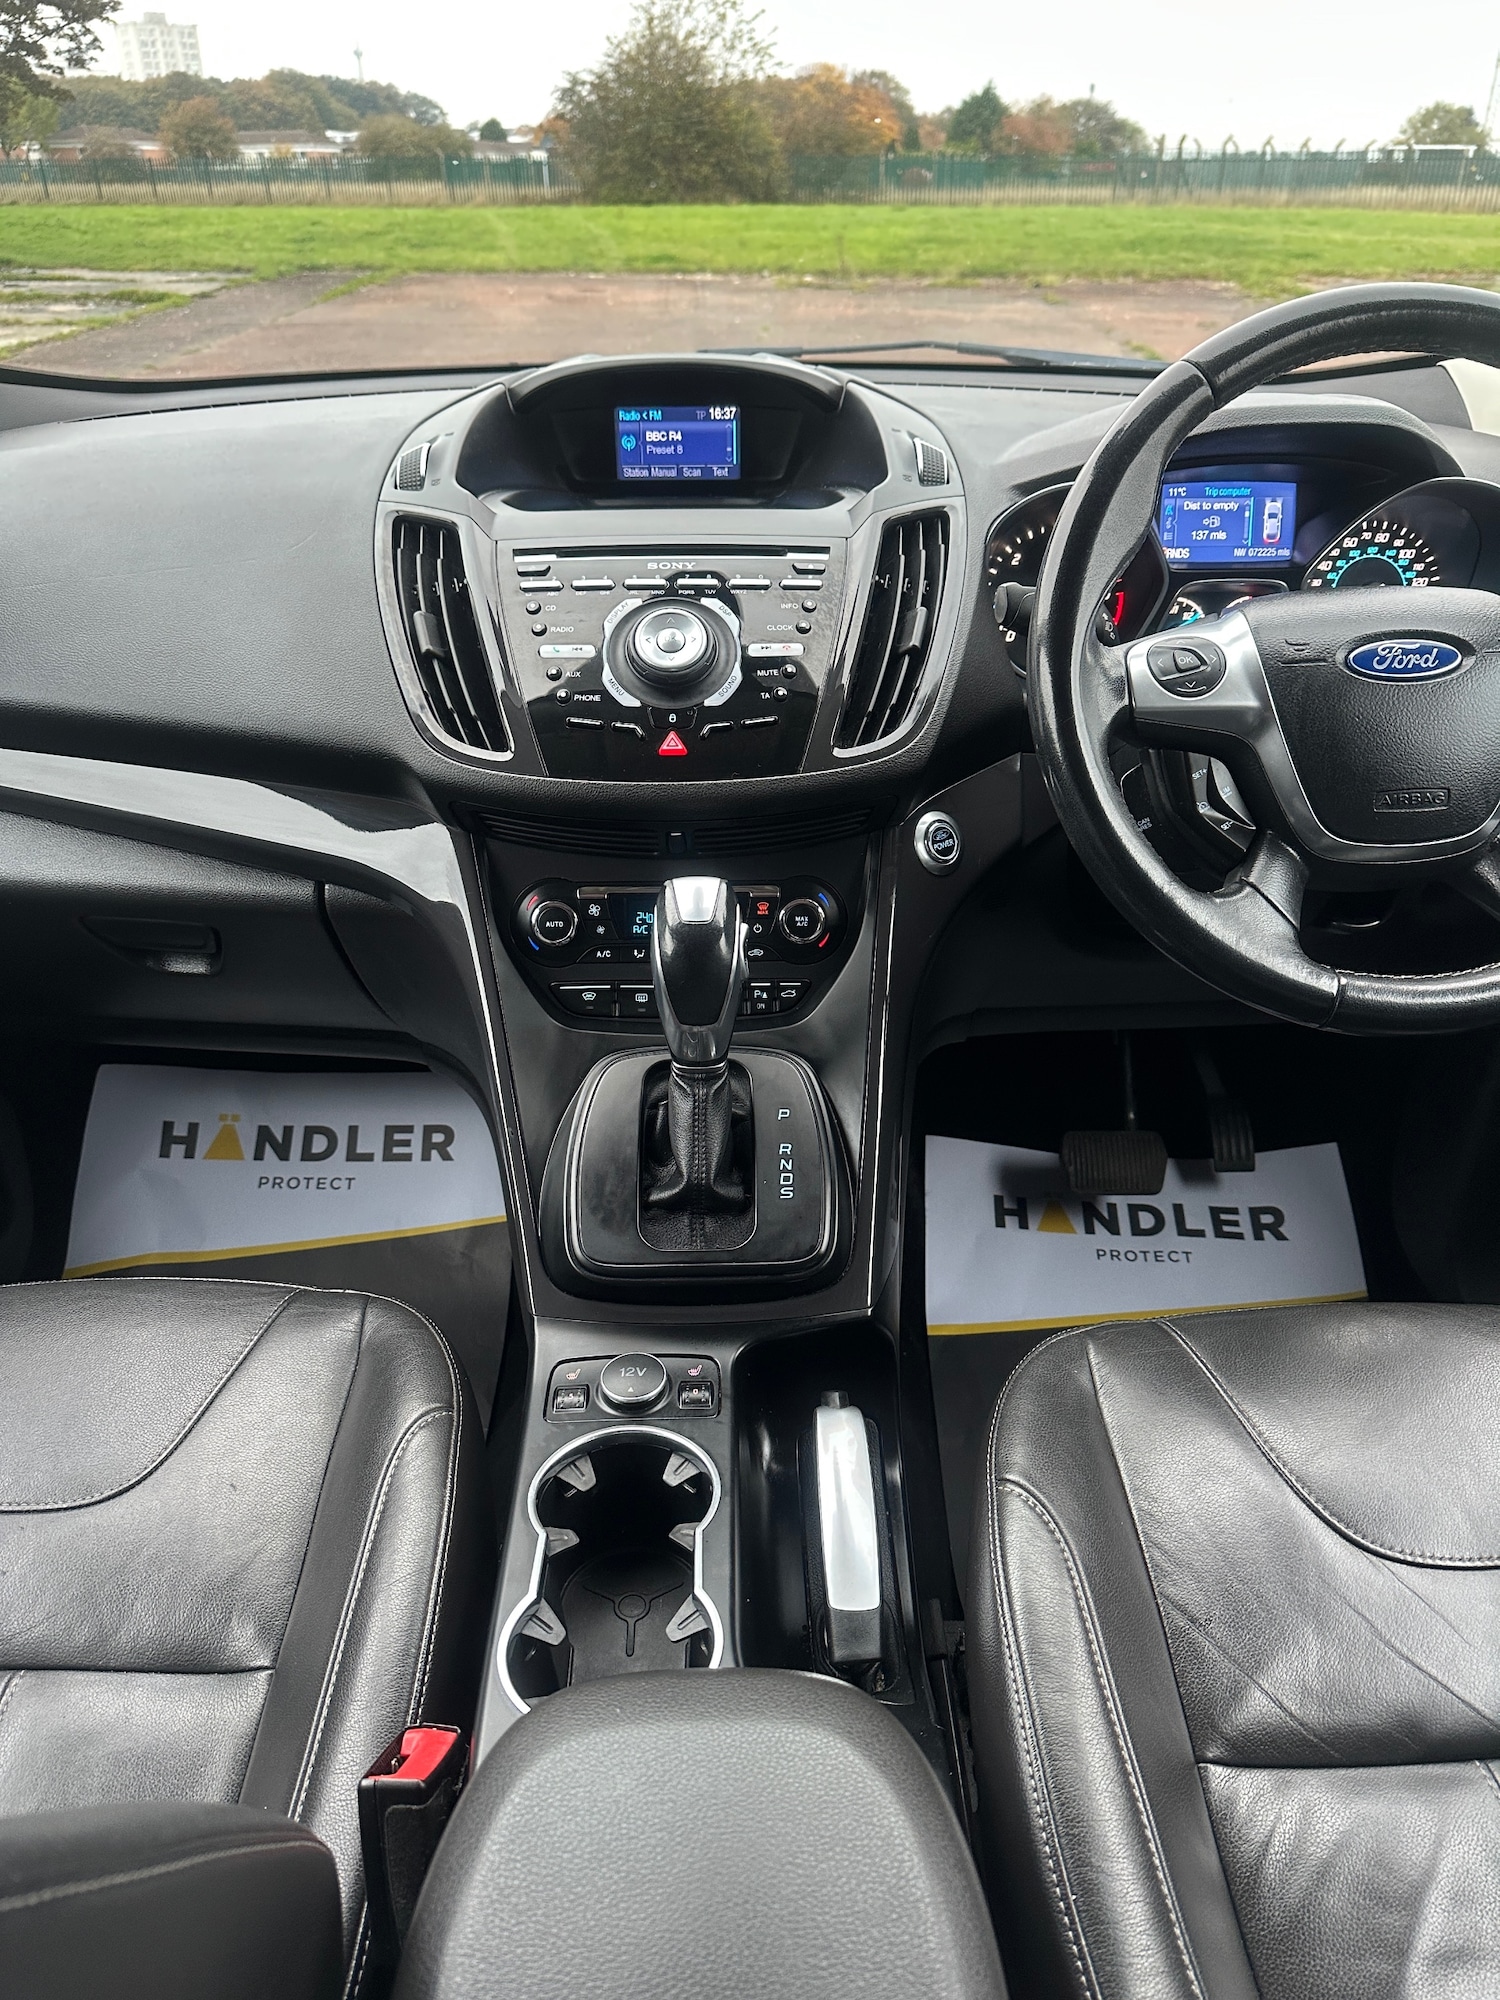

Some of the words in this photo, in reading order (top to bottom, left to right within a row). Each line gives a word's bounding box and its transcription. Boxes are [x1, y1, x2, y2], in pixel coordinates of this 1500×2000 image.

[619, 410, 640, 421] Radio
[649, 410, 662, 420] FM
[696, 411, 706, 420] TP
[709, 406, 737, 420] 16:37
[645, 430, 667, 441] BBC
[668, 430, 682, 441] R4
[646, 445, 675, 455] Preset
[676, 445, 684, 455] 8
[623, 467, 649, 477] Station
[651, 467, 677, 477] Manual
[682, 467, 702, 477] Scan
[712, 467, 729, 477] Text
[1204, 487, 1218, 496] Trip
[1219, 487, 1252, 496] computer
[1183, 501, 1200, 511] Dist
[1202, 502, 1211, 511] to
[1213, 502, 1239, 512] empty
[1191, 530, 1208, 541] 137
[1360, 532, 1372, 540] 70
[1342, 537, 1358, 548] 60
[1010, 553, 1022, 566] 2
[1398, 549, 1416, 559] 100
[1316, 561, 1332, 571] 40
[1411, 577, 1429, 587] 120
[607, 602, 629, 624] DISPLAY
[718, 605, 733, 617] DSP
[1178, 656, 1194, 665] OK
[1372, 642, 1440, 670] Ford
[757, 669, 779, 677] MUTE
[607, 678, 625, 696] MENU
[718, 675, 738, 697] SOUND
[573, 694, 602, 702] PHONE
[1379, 791, 1446, 806] AIRBAG
[933, 838, 955, 851] POWER
[632, 924, 649, 935] A/C
[596, 950, 612, 958] A/C
[778, 1108, 790, 1120] P
[779, 1144, 792, 1155] R
[780, 1159, 793, 1171] N
[257, 1175, 356, 1191] PROTECT
[780, 1173, 793, 1185] D
[780, 1187, 794, 1199] S
[1096, 1247, 1193, 1264] PROTECT
[619, 1366, 647, 1378] 12V
